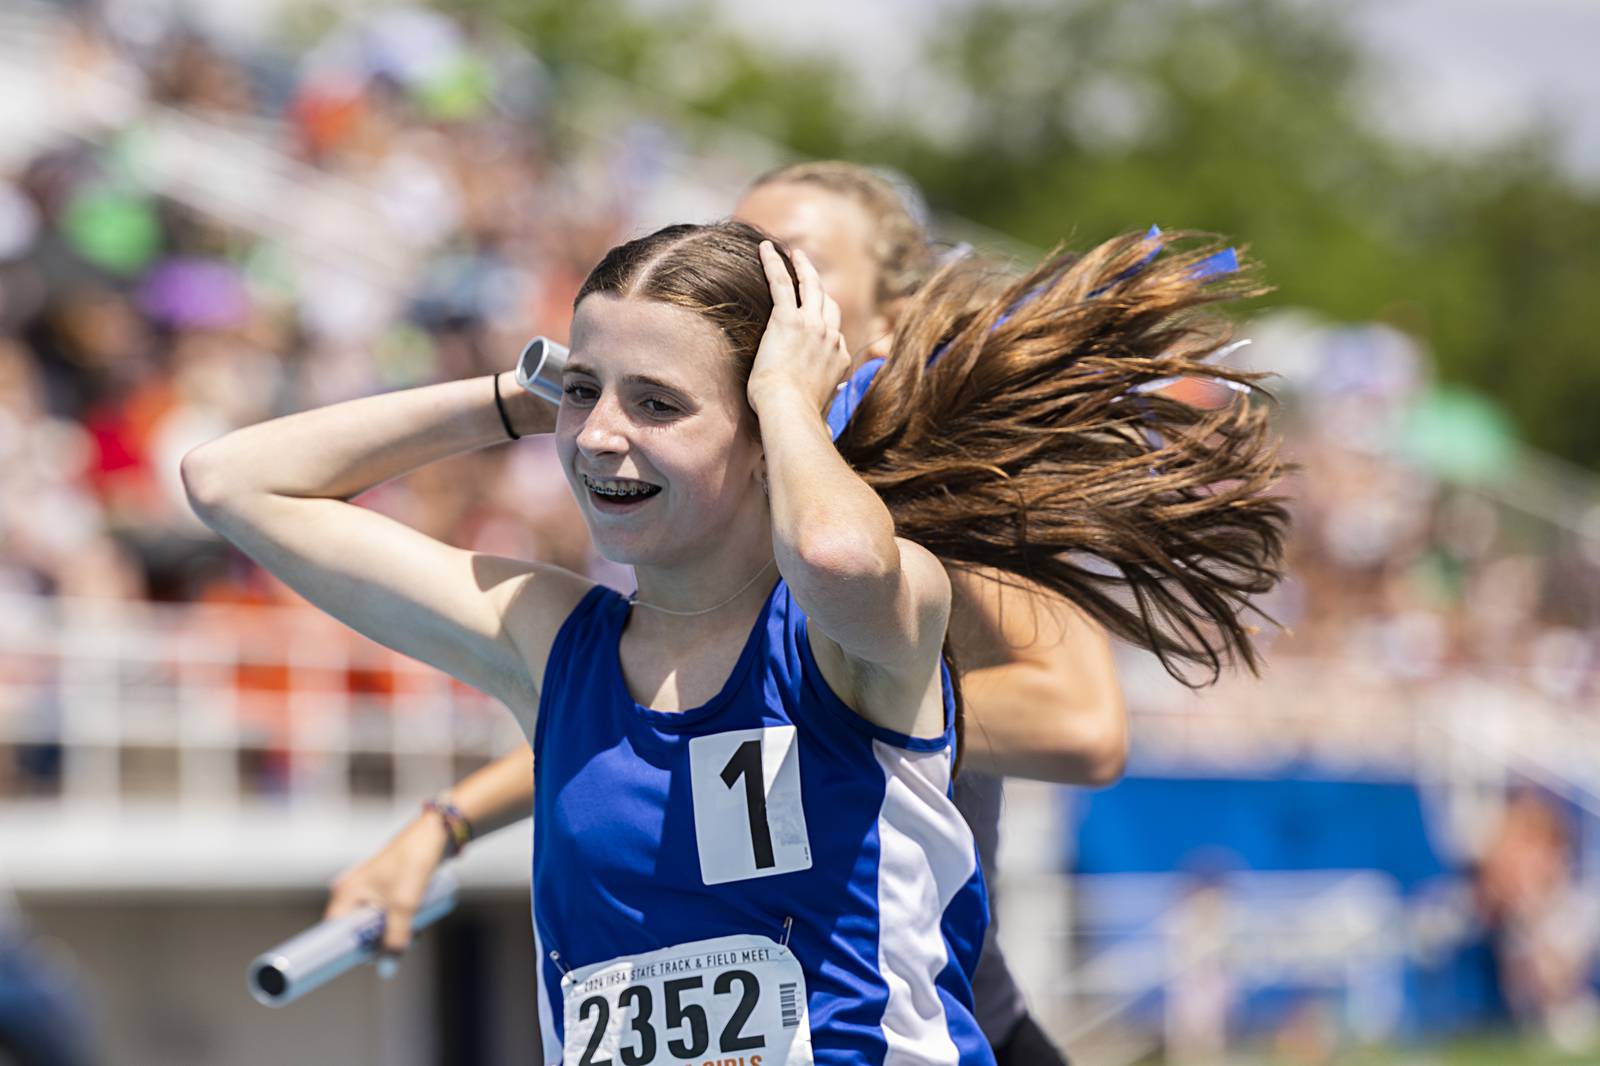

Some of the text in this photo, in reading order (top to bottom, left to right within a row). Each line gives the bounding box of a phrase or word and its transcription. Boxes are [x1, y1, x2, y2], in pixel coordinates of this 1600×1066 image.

[720, 740, 775, 869] 1
[631, 965, 656, 981] STATE
[660, 958, 691, 975] TRACK
[707, 951, 737, 966] FIELD
[742, 949, 771, 962] MEET
[578, 969, 766, 1066] 2352
